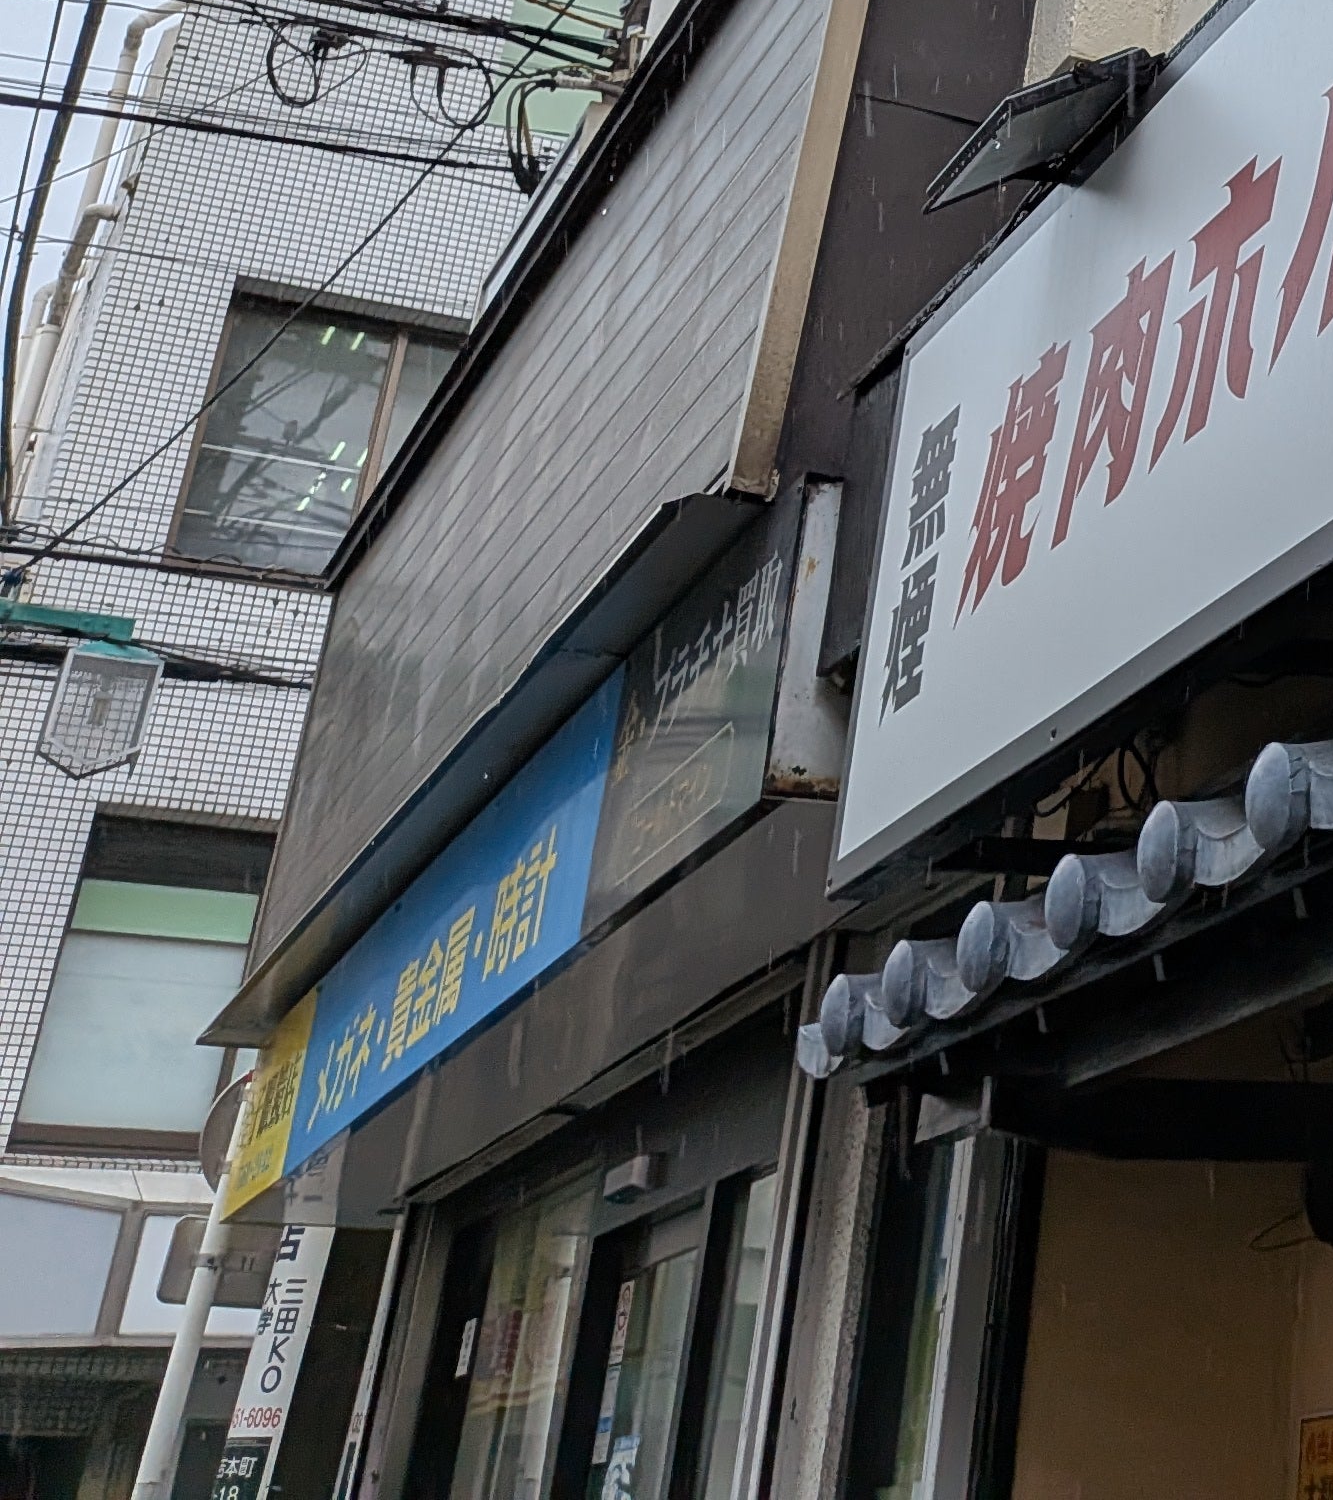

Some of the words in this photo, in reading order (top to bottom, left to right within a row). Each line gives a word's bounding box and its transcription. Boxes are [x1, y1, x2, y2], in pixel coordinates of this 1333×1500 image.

[879, 404, 961, 726] 無煙
[308, 824, 559, 1133] メガネ・貴金属・時計
